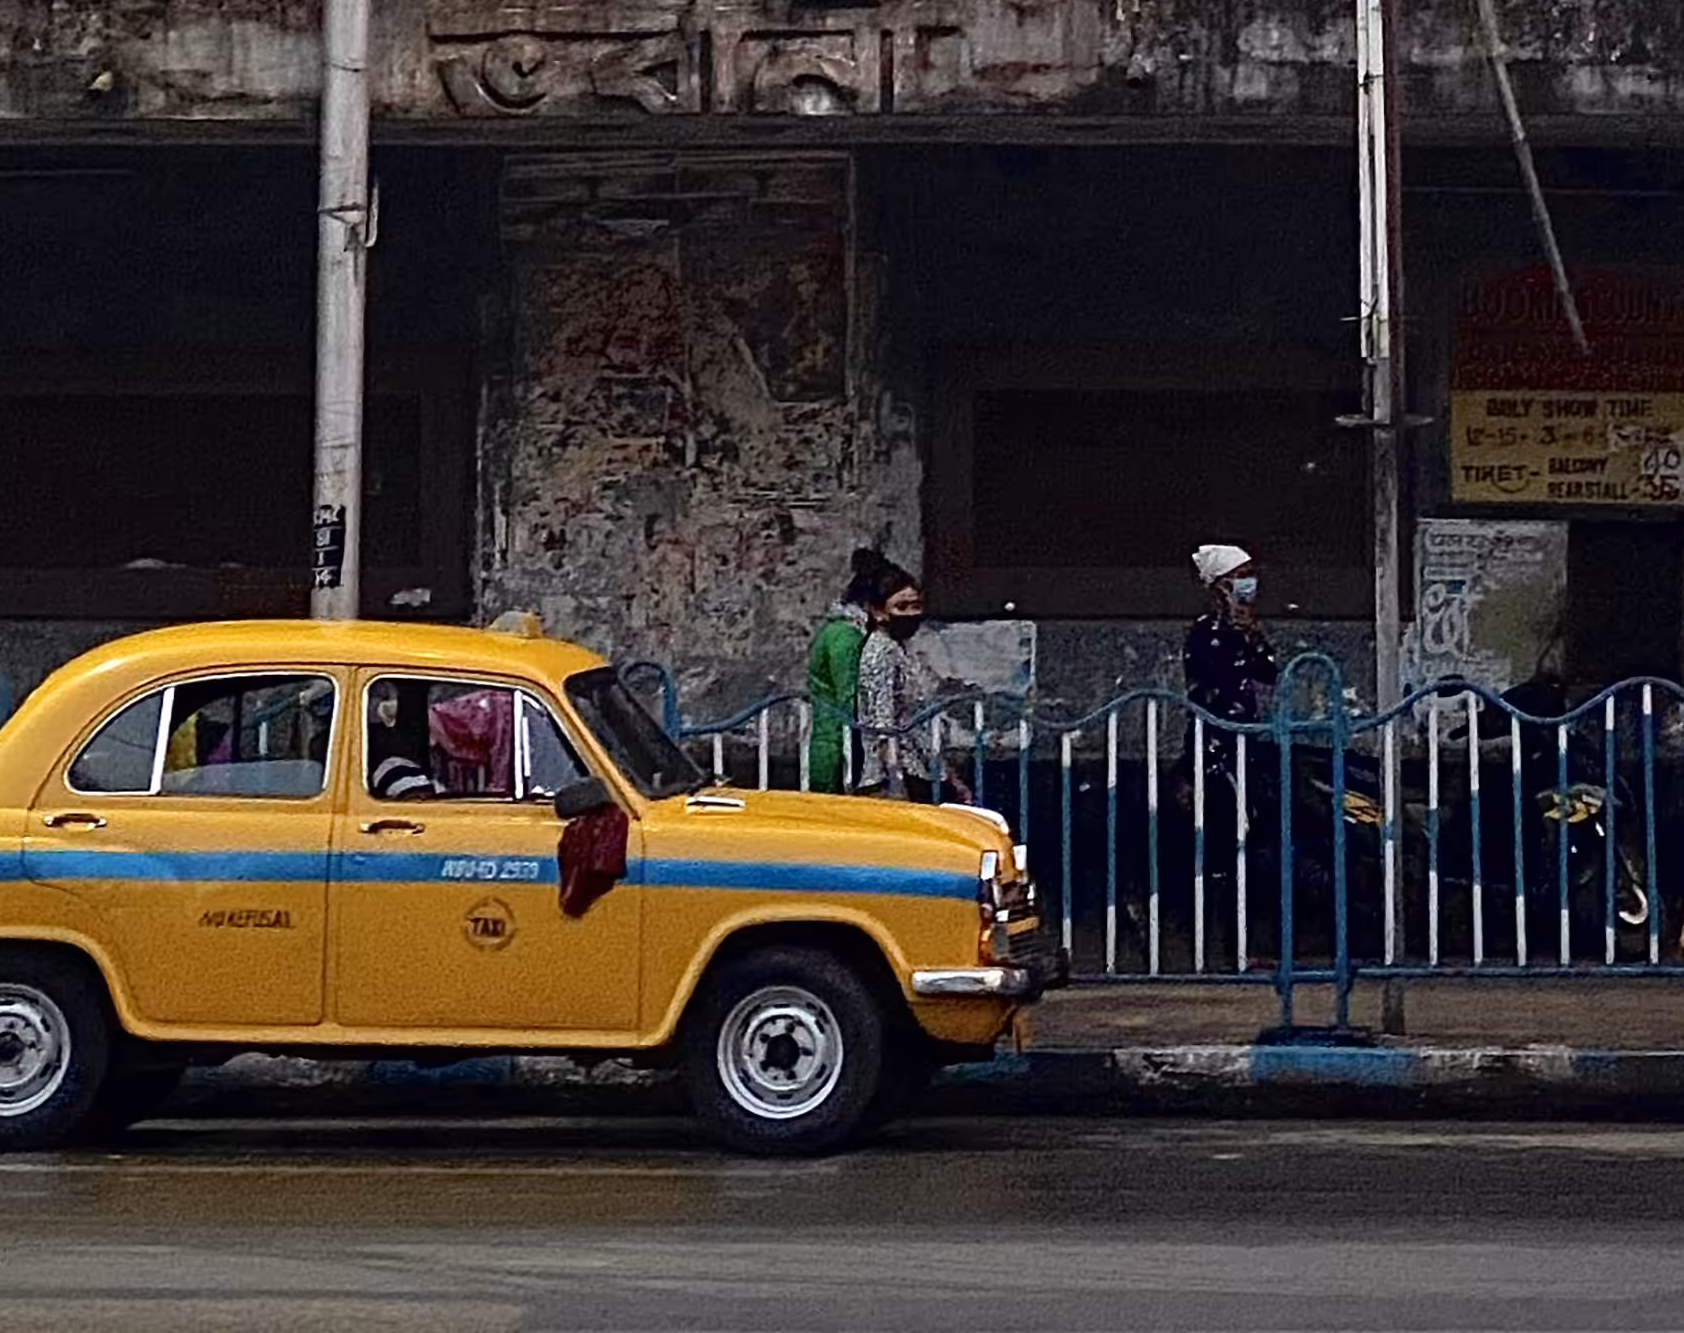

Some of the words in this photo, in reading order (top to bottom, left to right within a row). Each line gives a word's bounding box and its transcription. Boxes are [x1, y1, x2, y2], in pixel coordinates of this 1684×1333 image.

[1542, 398, 1599, 419] SHOW
[1607, 397, 1655, 419] TIME
[470, 917, 506, 938] TAXI
